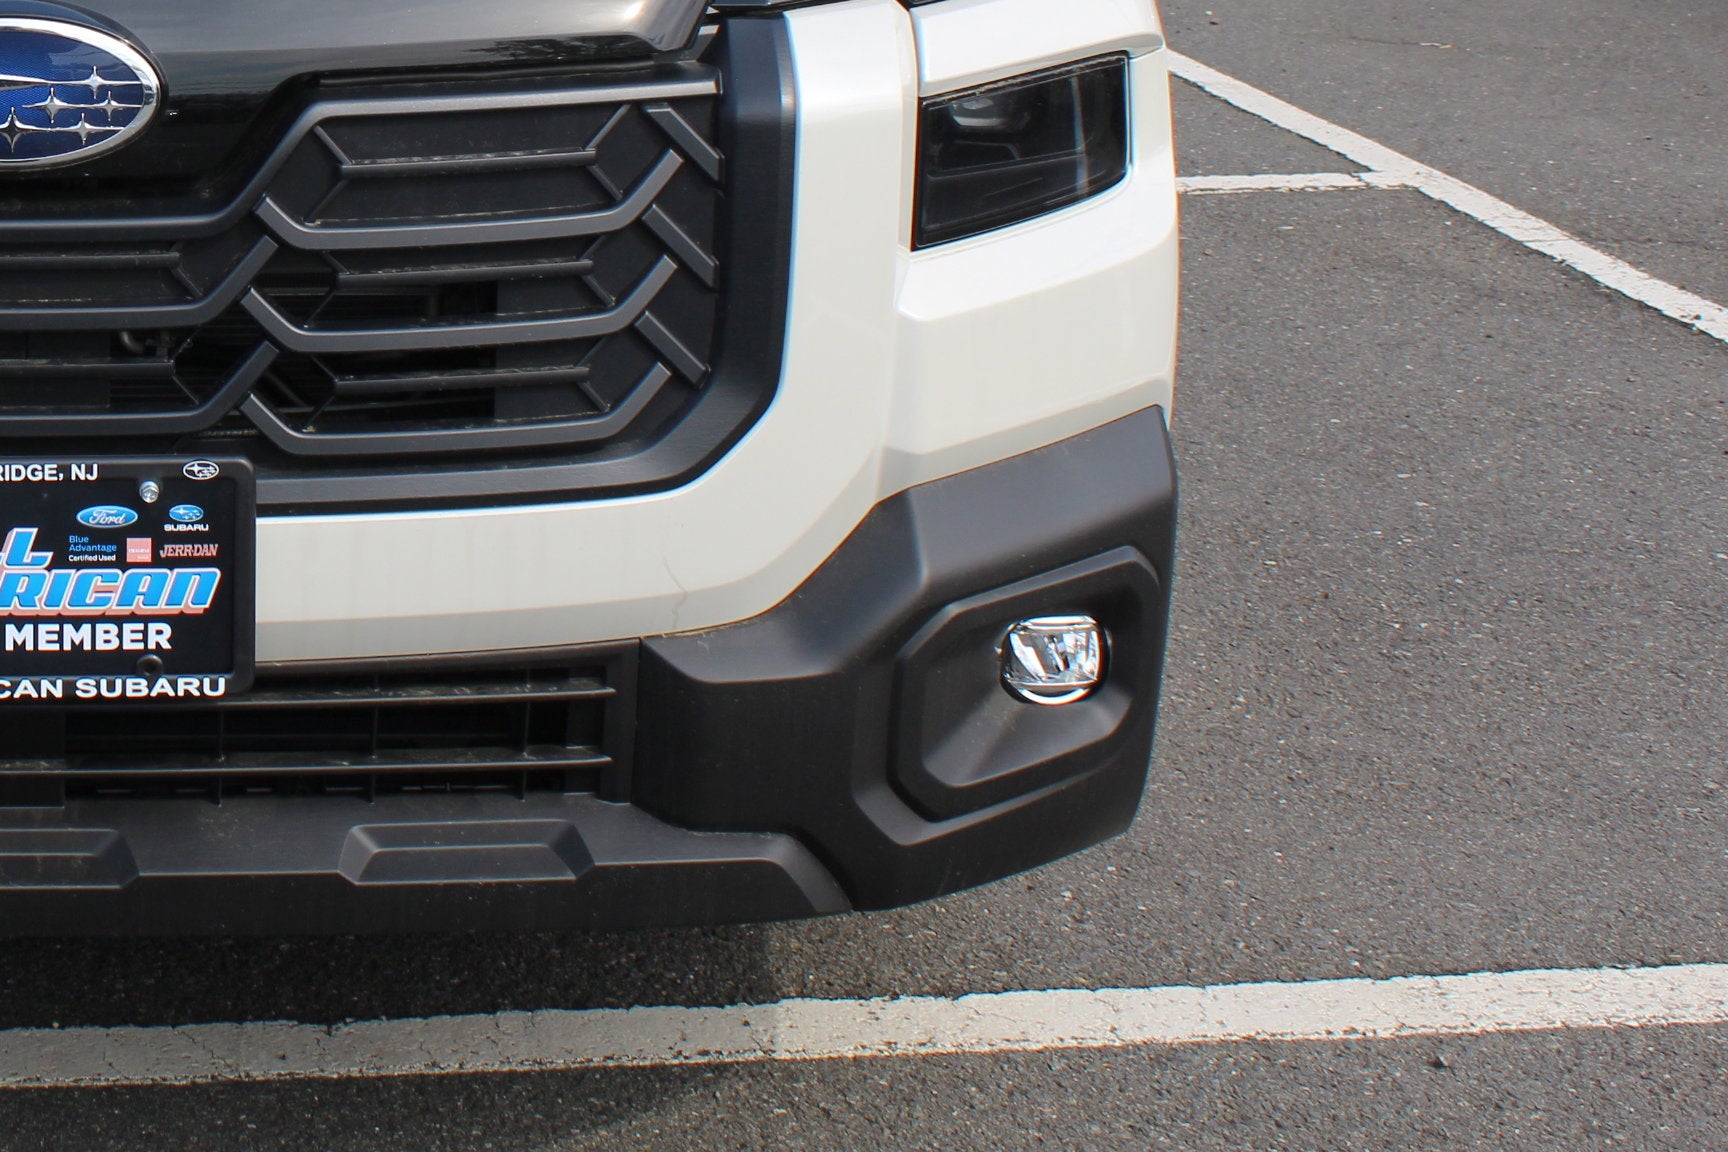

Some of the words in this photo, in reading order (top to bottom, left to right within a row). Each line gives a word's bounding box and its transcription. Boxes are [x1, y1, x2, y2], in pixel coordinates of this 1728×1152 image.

[70, 462, 99, 481] NJ
[89, 509, 126, 524] Ford
[164, 523, 209, 532] SUBARU
[69, 535, 89, 544] Blue
[69, 544, 117, 553] Advantage
[69, 554, 97, 562] Certified
[98, 554, 116, 562] Used
[5, 624, 172, 650] MEMBER
[75, 677, 226, 697] SUBARU
